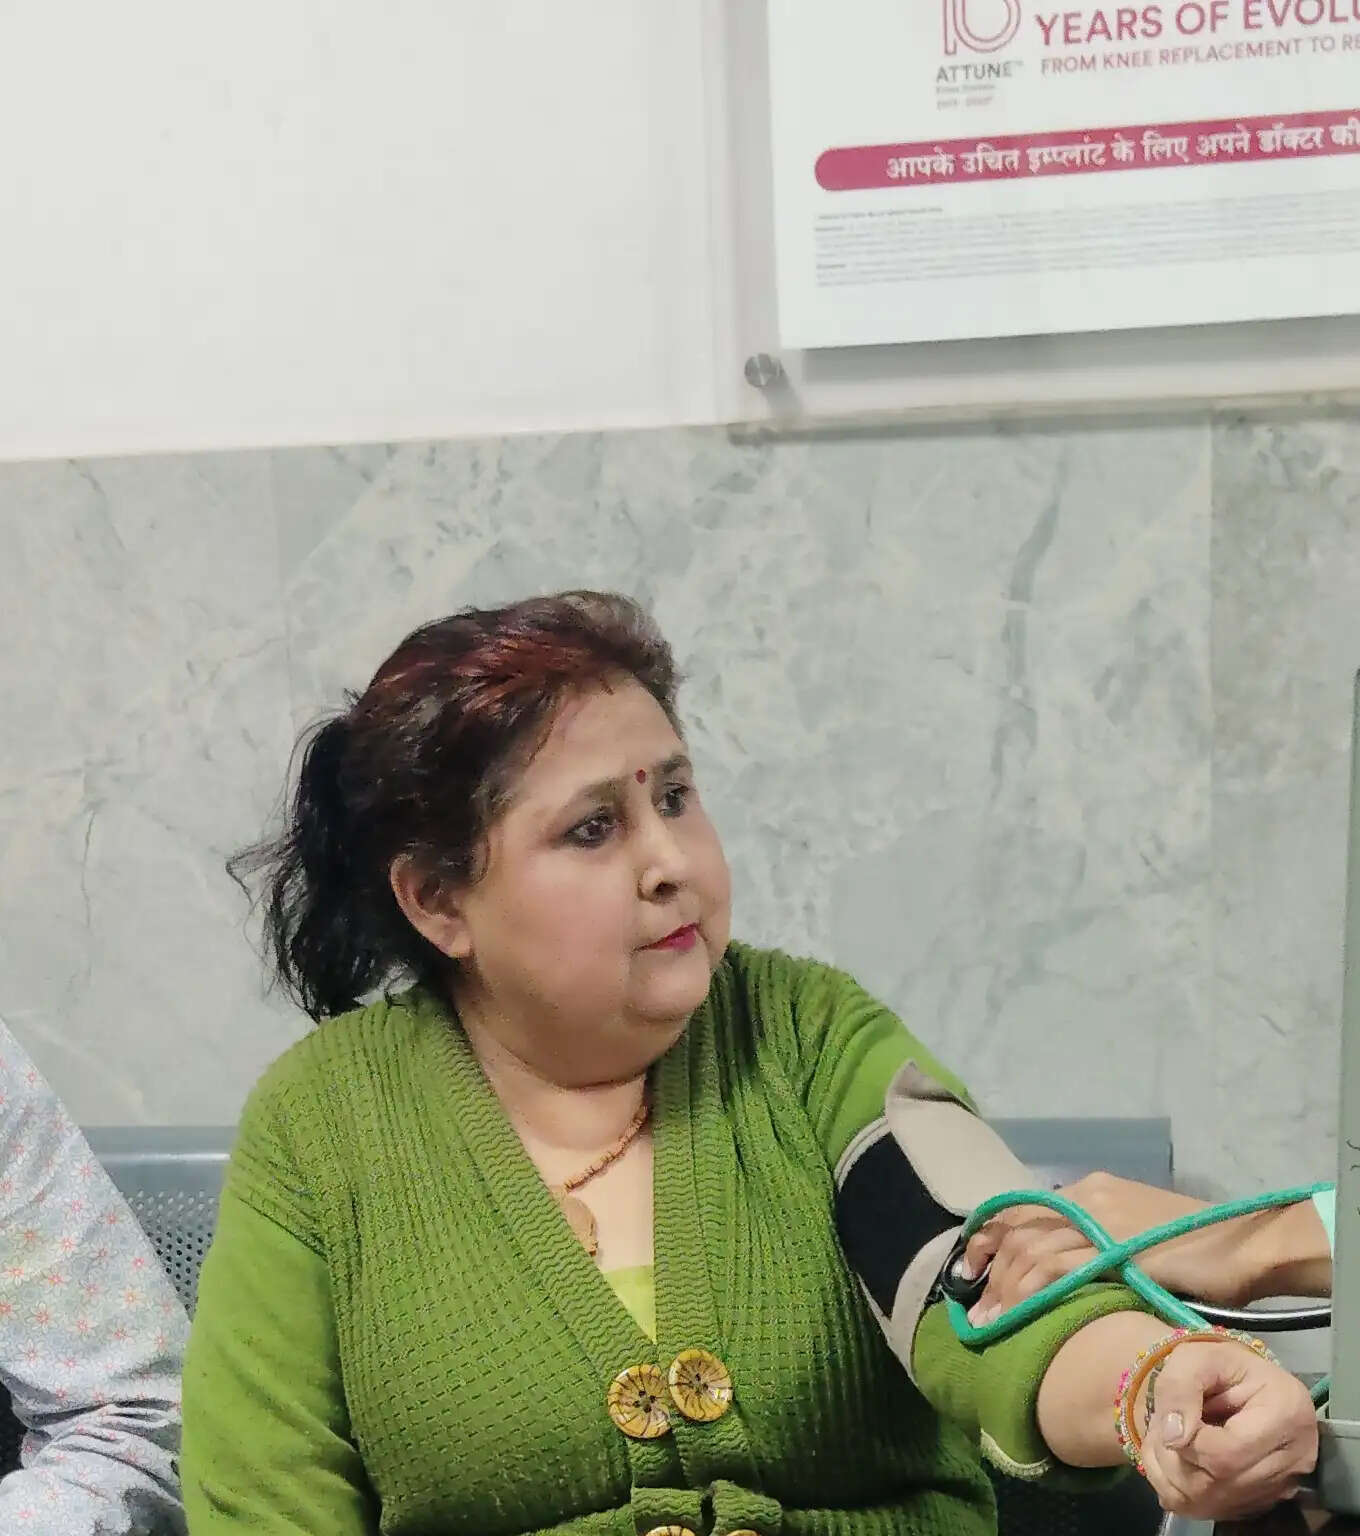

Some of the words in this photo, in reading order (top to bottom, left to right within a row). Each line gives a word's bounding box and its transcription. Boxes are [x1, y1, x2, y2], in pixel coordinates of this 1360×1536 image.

[1034, 6, 1163, 46] YEARS
[1175, 0, 1229, 36] OF
[1041, 55, 1097, 75] FROM
[1103, 49, 1154, 70] KNEE
[1159, 36, 1302, 66] REPLACEMENT
[1309, 35, 1336, 53] TO
[886, 146, 955, 179] आपके
[961, 142, 1021, 173] उचित
[1110, 132, 1135, 162] के
[1143, 129, 1191, 163] लिए
[1196, 123, 1251, 157] अपने
